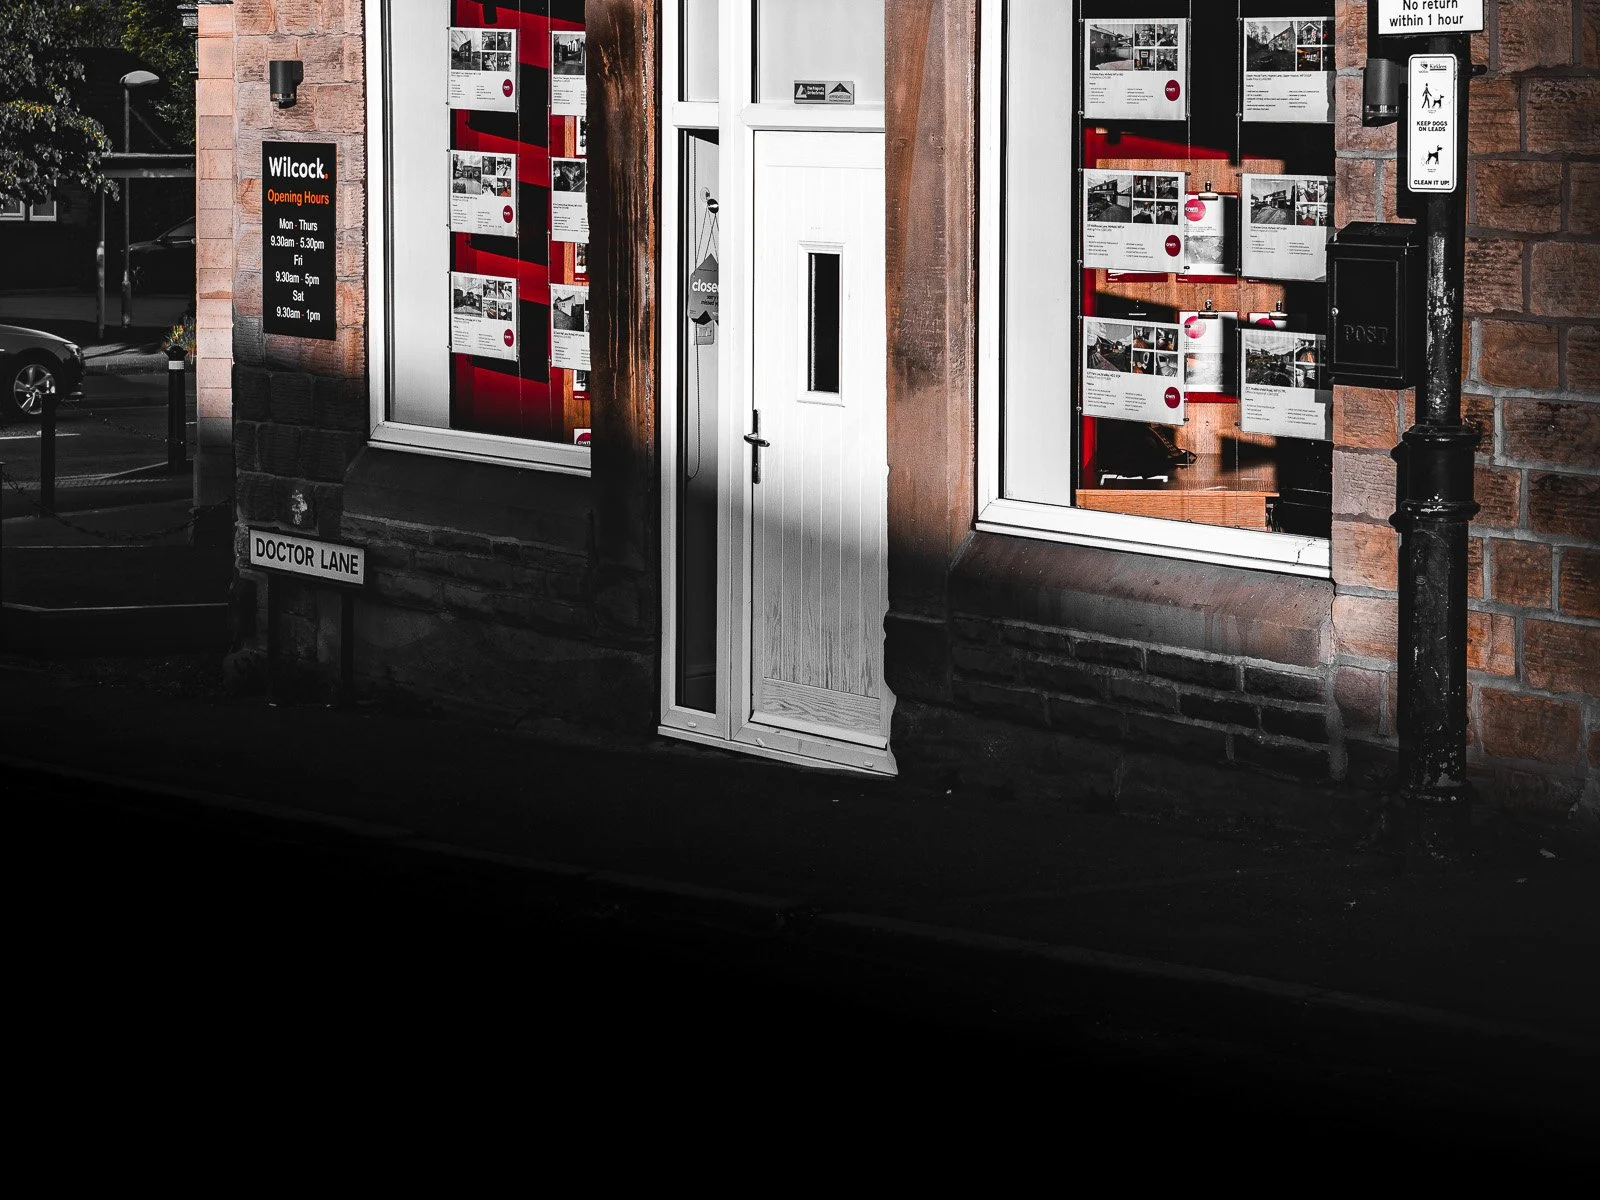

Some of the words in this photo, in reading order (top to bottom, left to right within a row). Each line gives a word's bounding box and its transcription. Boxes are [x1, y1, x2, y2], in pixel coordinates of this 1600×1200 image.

[1402, 0, 1418, 10] No
[1389, 14, 1423, 27] within
[1428, 14, 1432, 25] 1
[1437, 14, 1464, 25] hour
[267, 189, 303, 206] Opening
[304, 191, 329, 205] Hours
[279, 218, 293, 230] Mon
[299, 219, 318, 231] Thurs
[270, 236, 295, 248] 9.30am
[300, 238, 325, 251] 5.30pm
[294, 255, 303, 266] Fri
[275, 271, 300, 283] 9.30am
[305, 273, 320, 286] 5pm
[293, 290, 304, 302] Sat
[276, 307, 301, 319] 9.30am
[306, 309, 321, 322] 1pm
[1344, 325, 1388, 345] POST
[256, 538, 314, 567] DOCTOR
[321, 549, 358, 575] LANE
